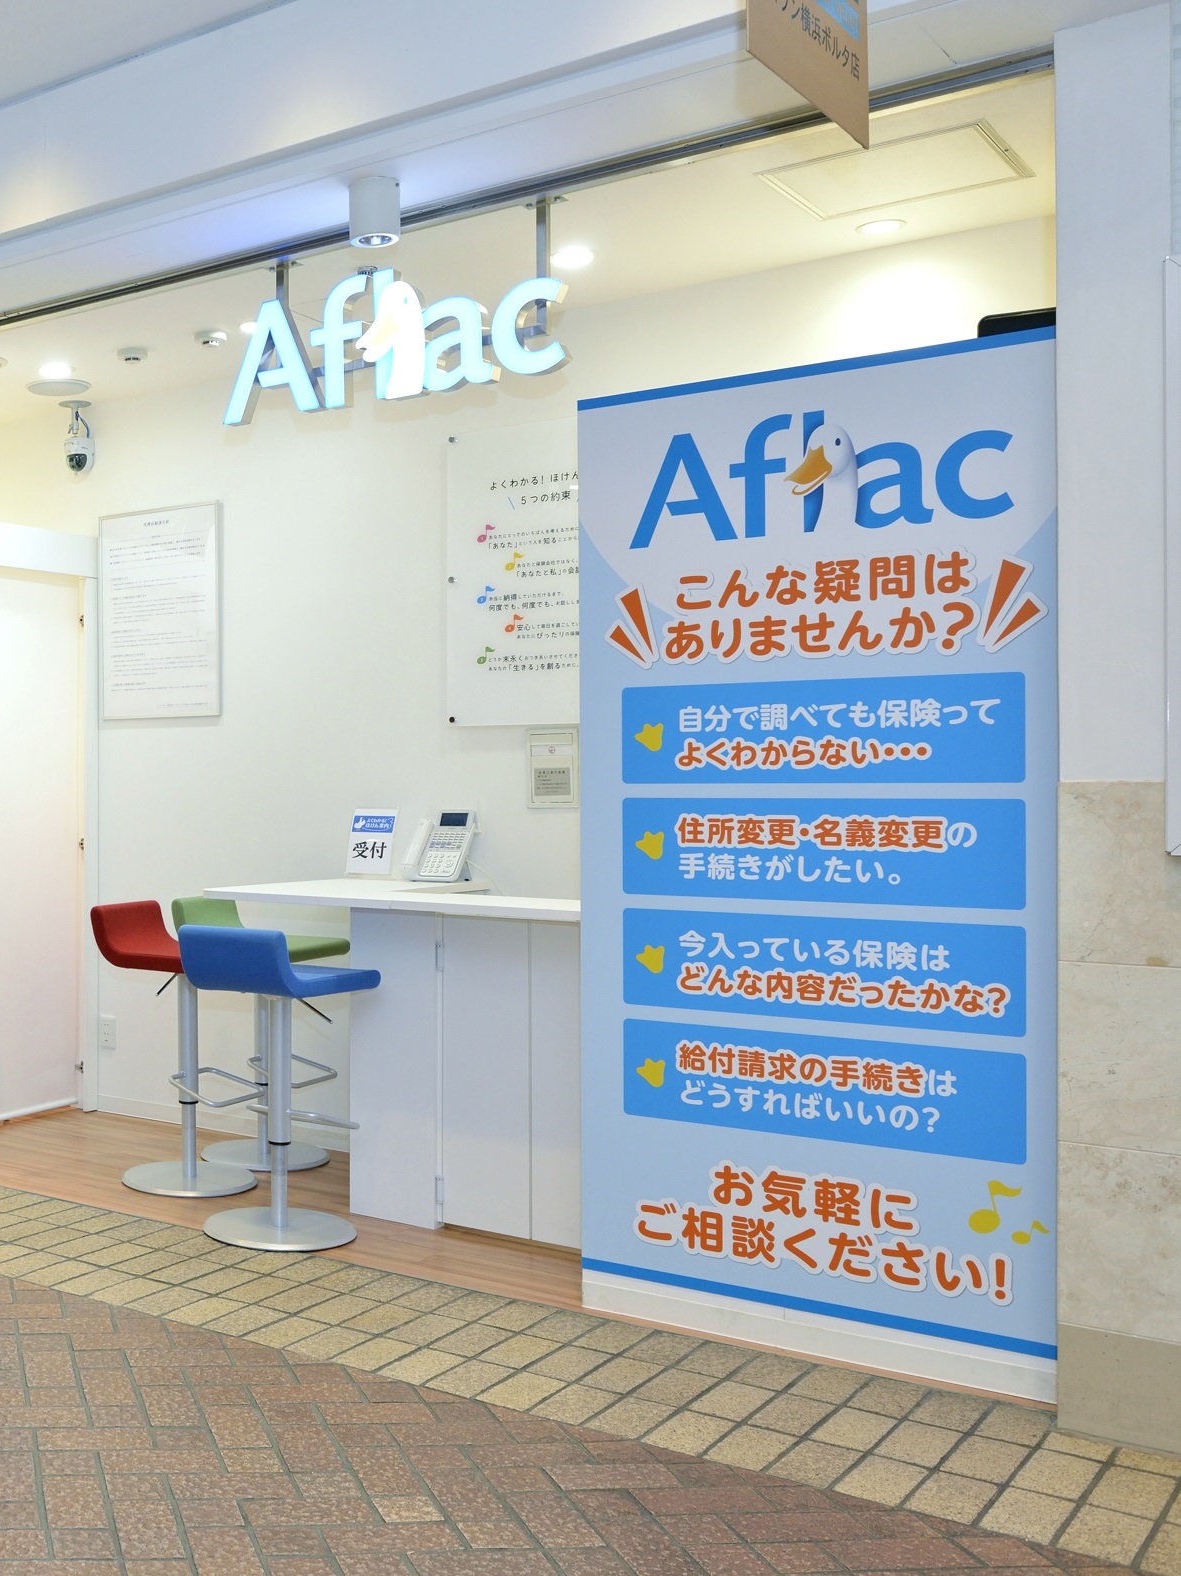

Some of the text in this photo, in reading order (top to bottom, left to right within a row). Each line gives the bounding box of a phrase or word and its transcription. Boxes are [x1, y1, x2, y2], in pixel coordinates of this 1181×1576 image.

[222, 267, 565, 425] Aflac
[521, 490, 571, 505] 5つの約束
[629, 410, 1015, 549] Aflac
[676, 551, 970, 610] こんな疑問は
[665, 602, 974, 659] ありませんか?
[679, 698, 1001, 732] 自分で調べても保険って
[352, 841, 387, 859] 受付
[678, 817, 977, 849] 住所変更・名義変更の
[679, 853, 900, 885] 手続きがしたい。
[679, 930, 950, 972] 今入っている保険は
[680, 965, 1006, 1014] どんな内容だったかな?
[679, 1043, 957, 1096] 給付請求の手続きは
[680, 1080, 941, 1132] どうすればいいの?
[713, 1165, 914, 1231] お気軽に
[638, 1202, 1007, 1300] ご相談ください!
